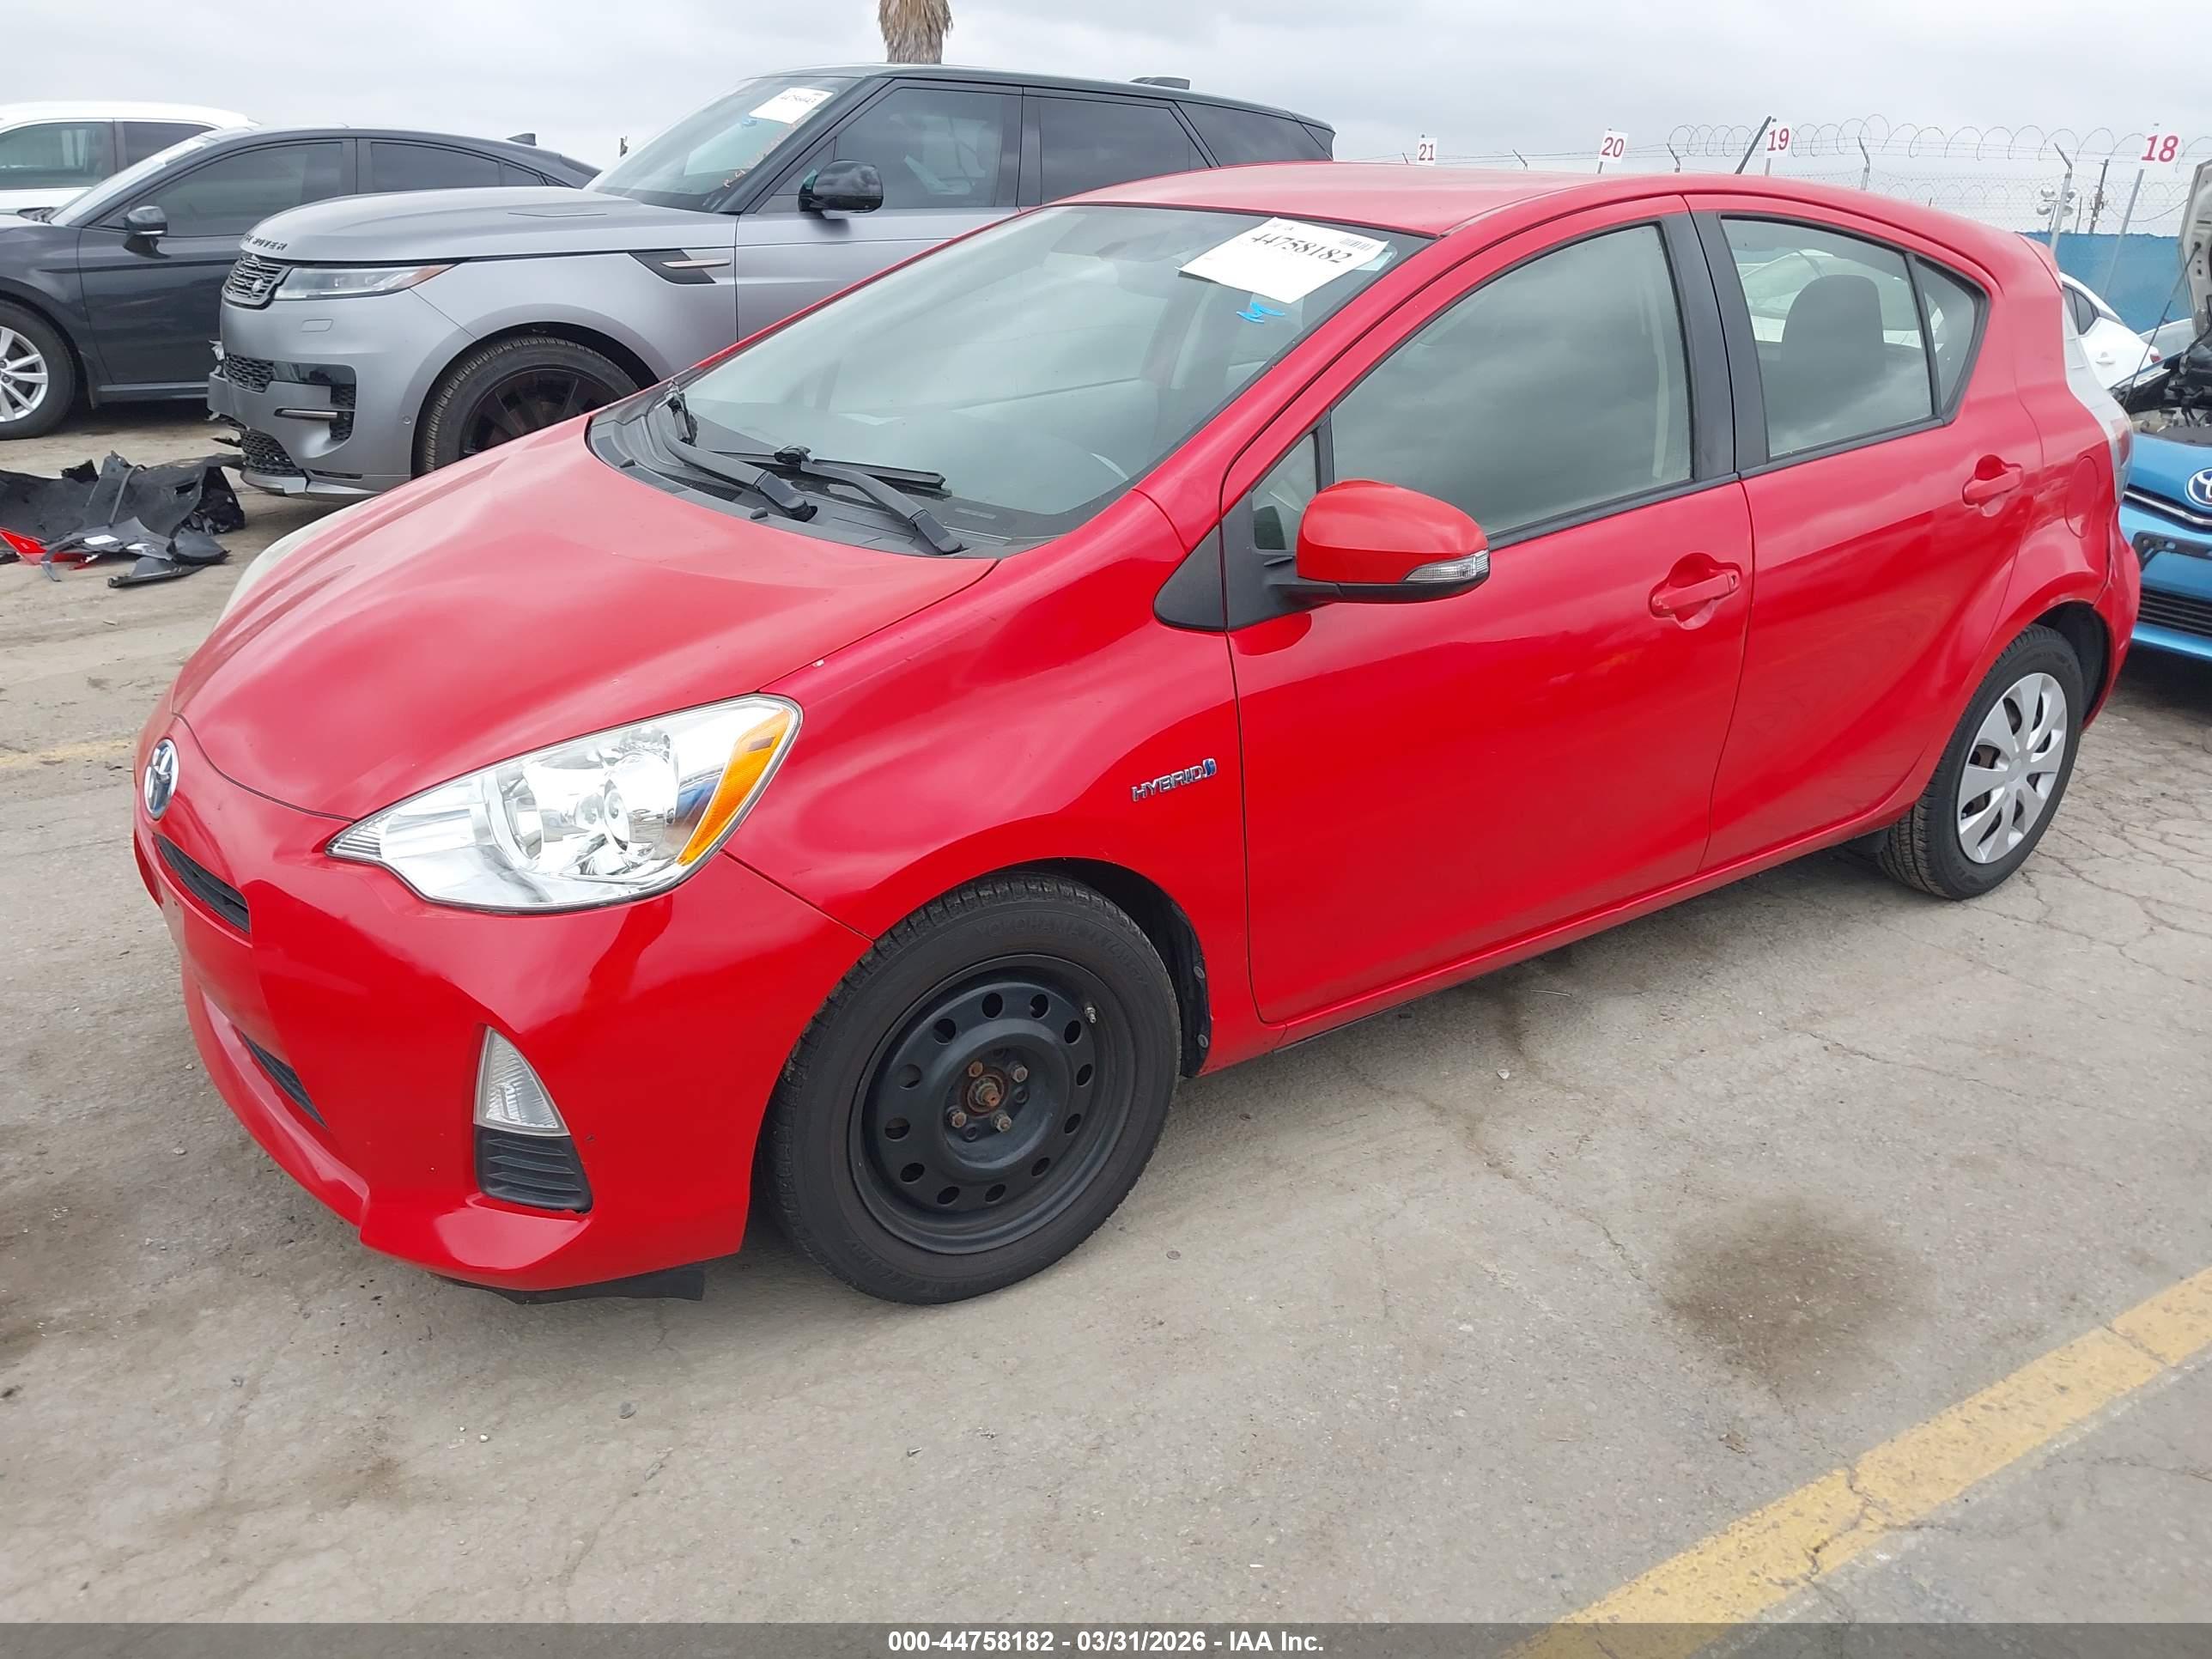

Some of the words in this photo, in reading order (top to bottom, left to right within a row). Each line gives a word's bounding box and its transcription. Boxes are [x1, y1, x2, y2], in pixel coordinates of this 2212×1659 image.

[1419, 143, 1435, 161] 21
[1601, 137, 1626, 158] 20
[1766, 127, 1790, 151] 19
[2141, 134, 2179, 163] 18
[1250, 233, 1353, 264] 44758182
[1131, 765, 1204, 802] HYBRID
